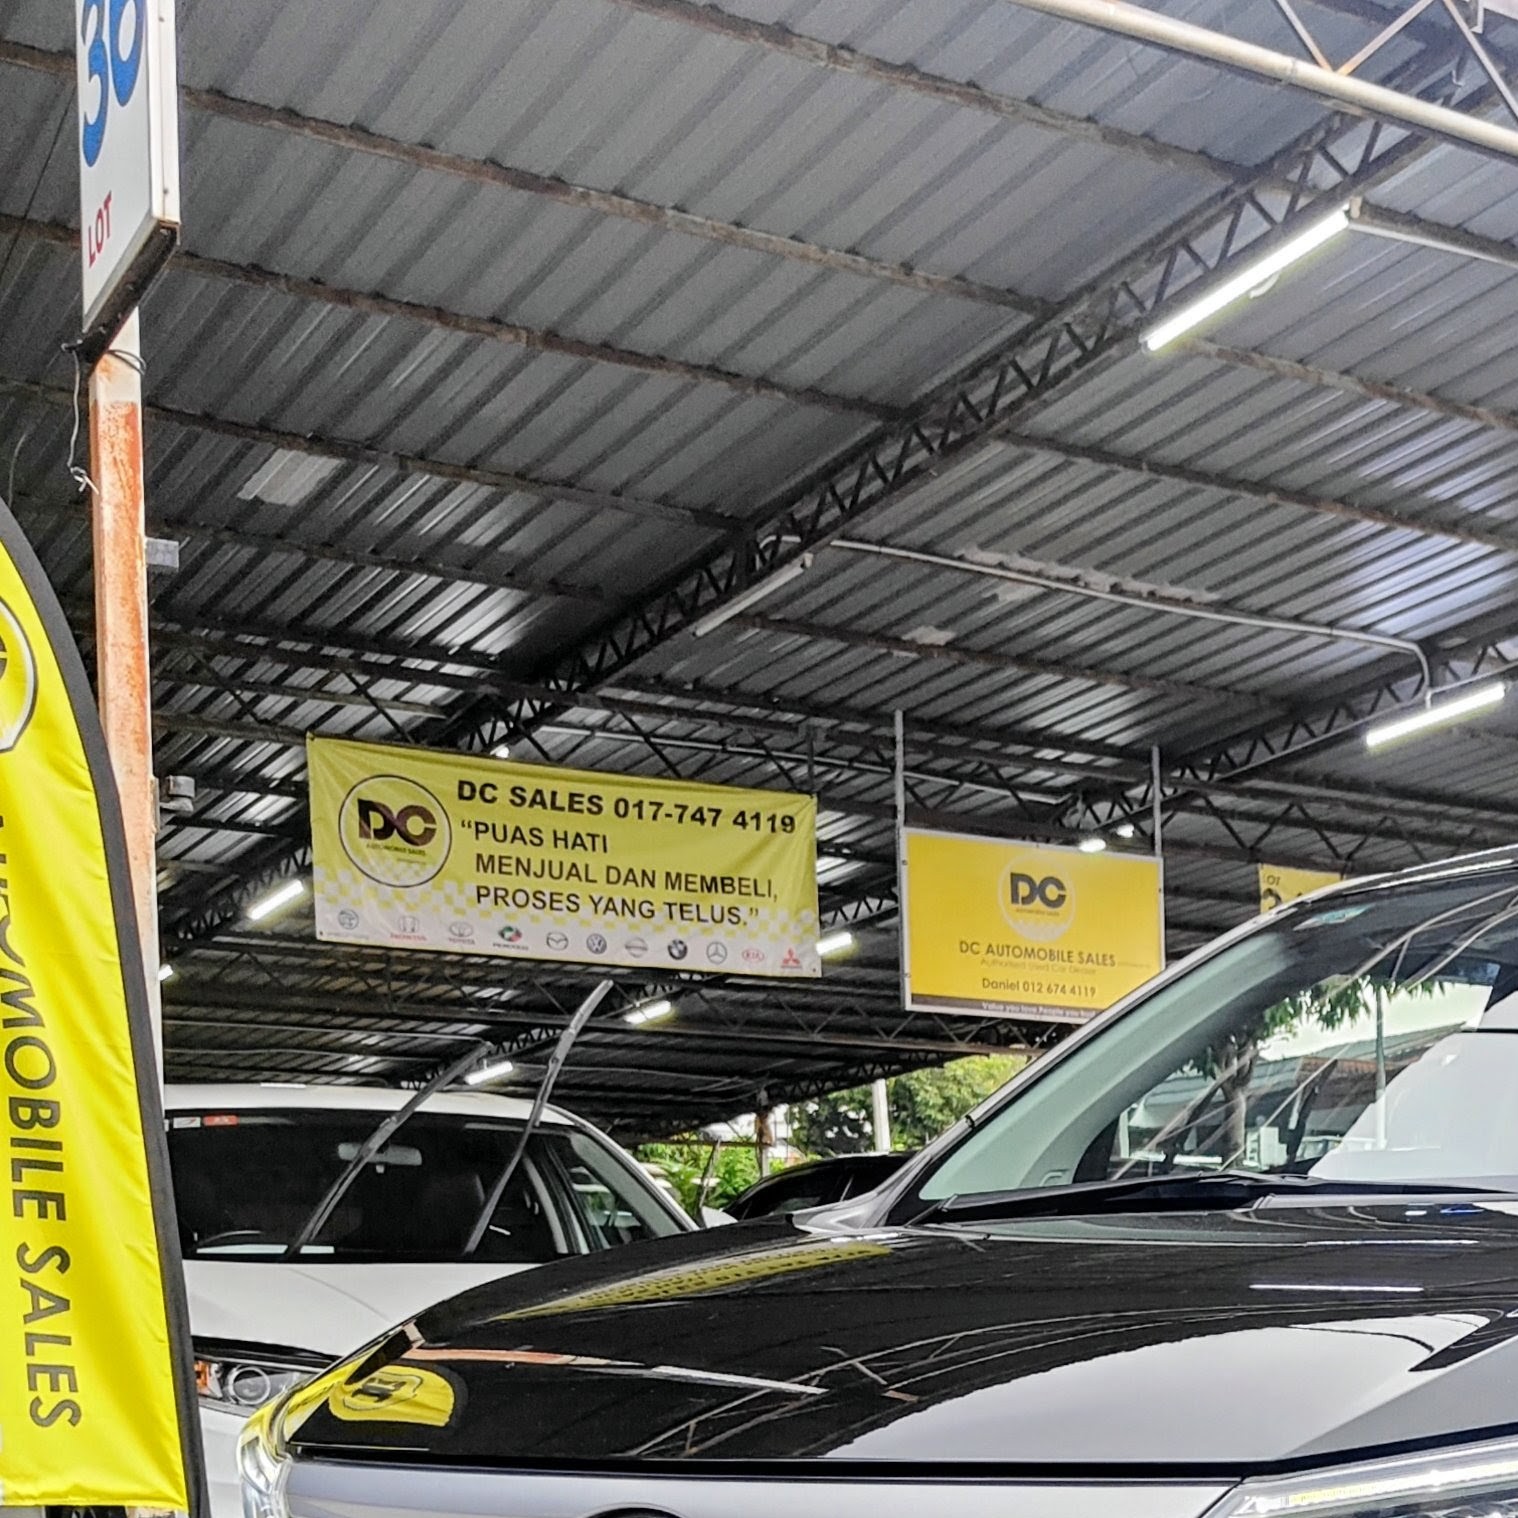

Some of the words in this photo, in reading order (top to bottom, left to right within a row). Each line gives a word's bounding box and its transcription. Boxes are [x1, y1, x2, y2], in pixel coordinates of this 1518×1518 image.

[81, 0, 147, 167] 30
[88, 190, 112, 268] LOT
[357, 798, 437, 846] DC
[457, 780, 498, 805] DC
[509, 786, 604, 816] SALES
[614, 797, 722, 827] 017-747
[733, 810, 796, 835] 4119
[553, 829, 609, 854] HATI
[475, 854, 598, 884] MENJUAL
[605, 864, 657, 890] DAN
[664, 871, 778, 902] MEMBELI,
[1010, 872, 1066, 909] DC
[476, 885, 580, 914] PROSES
[591, 894, 656, 922] YANG
[959, 940, 981, 955] DC
[985, 944, 1073, 963] AUTOMOBILE
[1078, 952, 1116, 967] SALES
[982, 978, 1020, 991] Daniel
[1022, 981, 1043, 993] 012
[1047, 983, 1066, 994] 674
[1070, 985, 1096, 998] 4119
[16, 1242, 82, 1428] SALES
